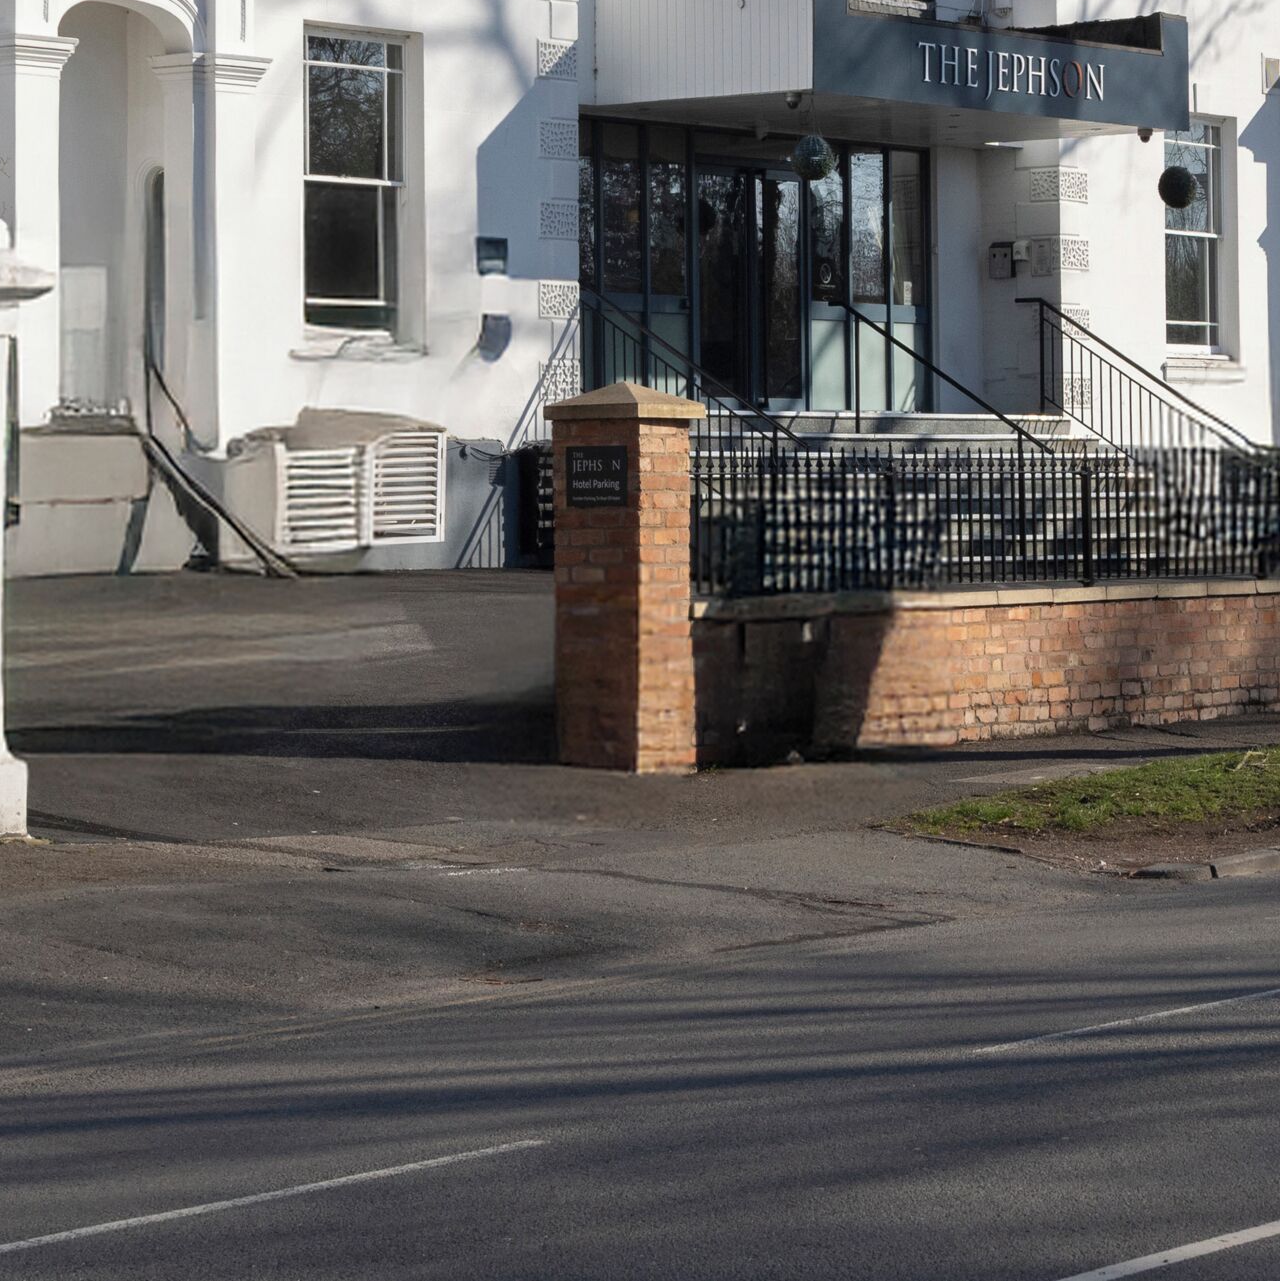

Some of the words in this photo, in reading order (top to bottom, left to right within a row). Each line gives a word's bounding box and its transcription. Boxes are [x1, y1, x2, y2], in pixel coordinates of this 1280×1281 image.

[919, 42, 978, 87] THE
[985, 50, 1105, 101] JEPHSON
[572, 480, 591, 488] Hotel
[593, 480, 620, 490] Parking
